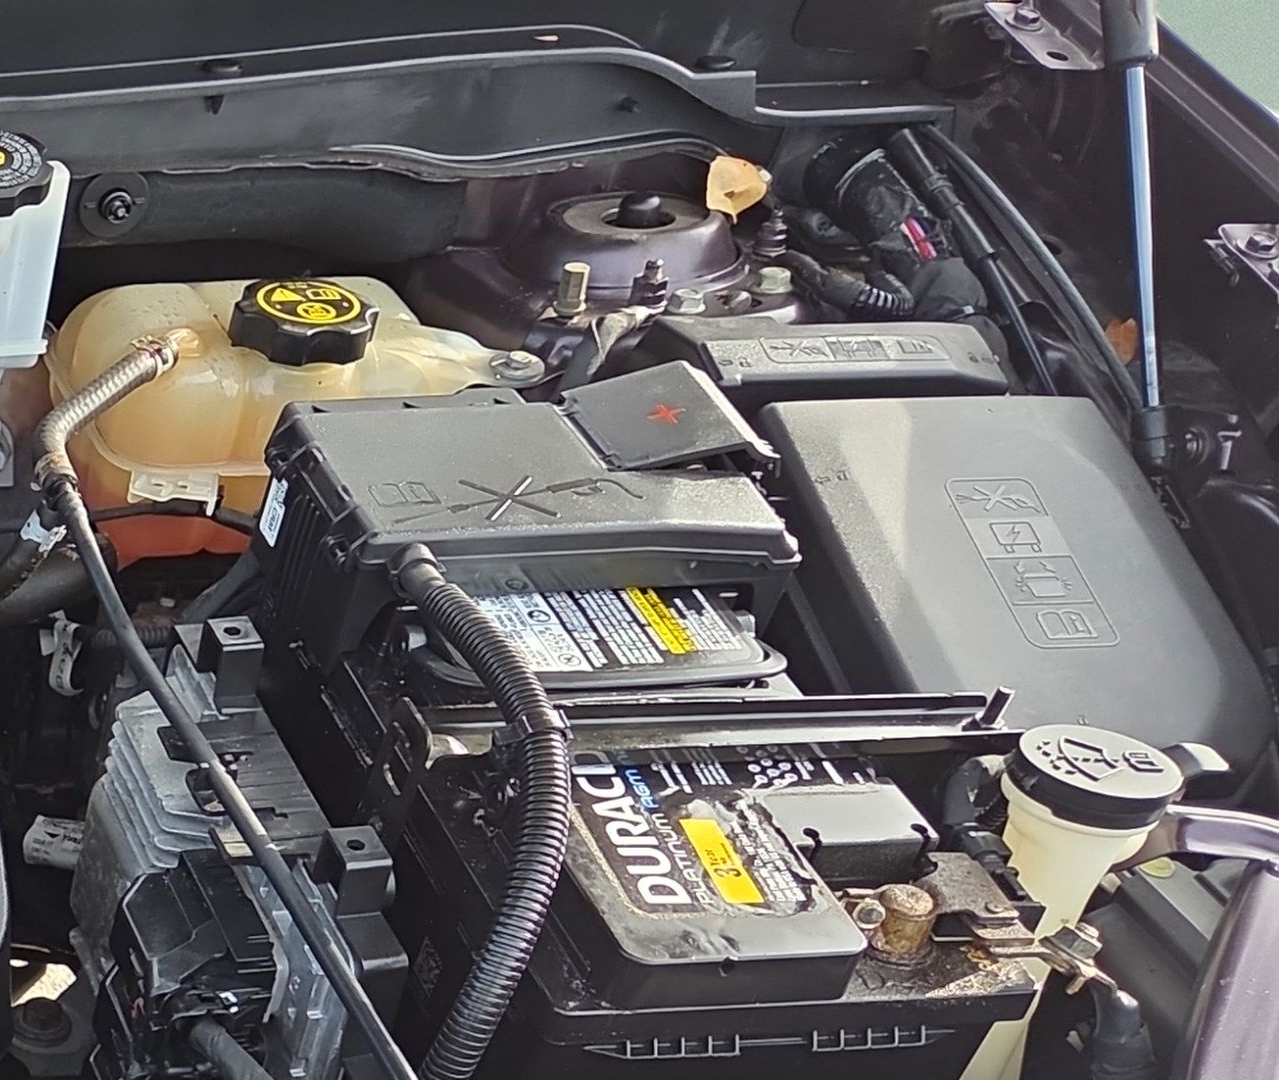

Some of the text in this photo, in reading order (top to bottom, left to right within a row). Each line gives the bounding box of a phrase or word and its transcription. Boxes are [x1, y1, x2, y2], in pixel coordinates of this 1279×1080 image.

[625, 769, 659, 808] AGM
[570, 763, 693, 905] DURAC
[651, 812, 715, 905] PLATINUM
[713, 867, 742, 878] 3
